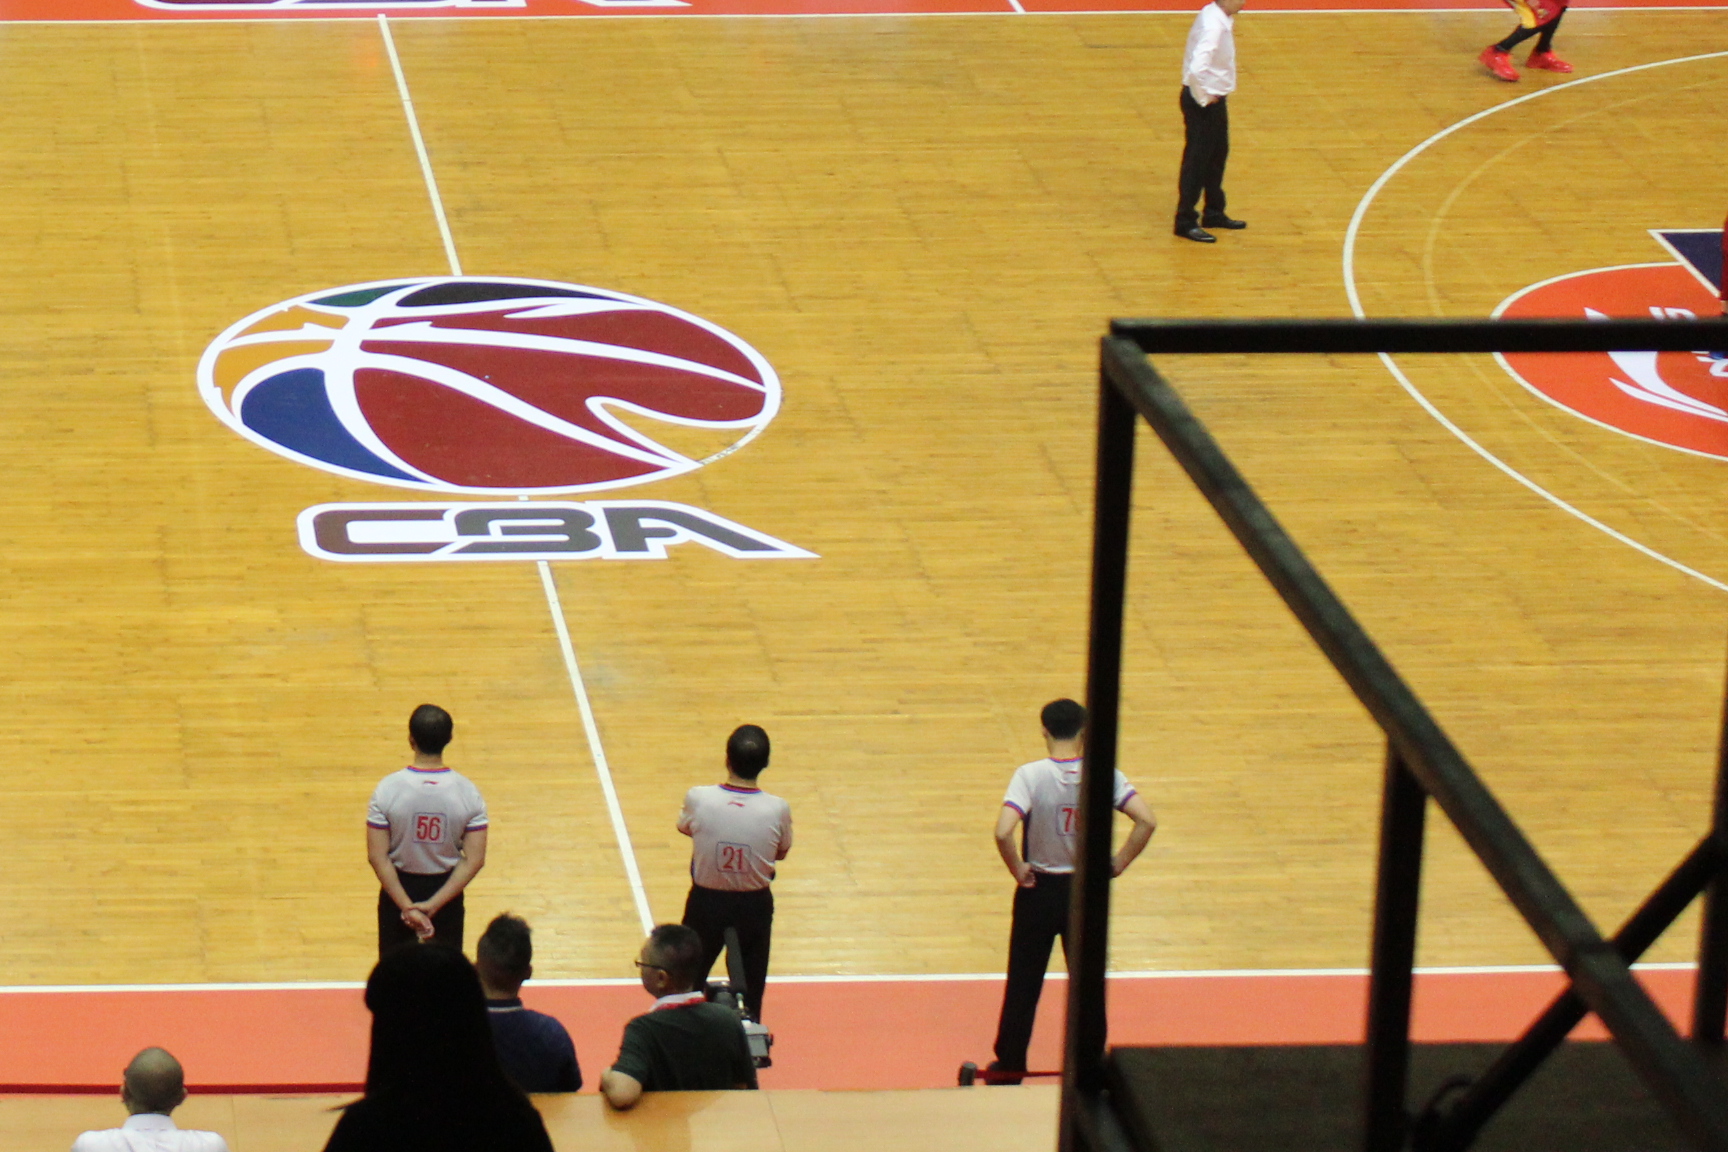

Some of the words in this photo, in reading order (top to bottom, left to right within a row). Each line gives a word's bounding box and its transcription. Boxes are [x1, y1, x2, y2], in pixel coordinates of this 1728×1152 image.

[296, 500, 822, 563] CBA
[416, 815, 442, 843] 56
[722, 845, 745, 873] 21
